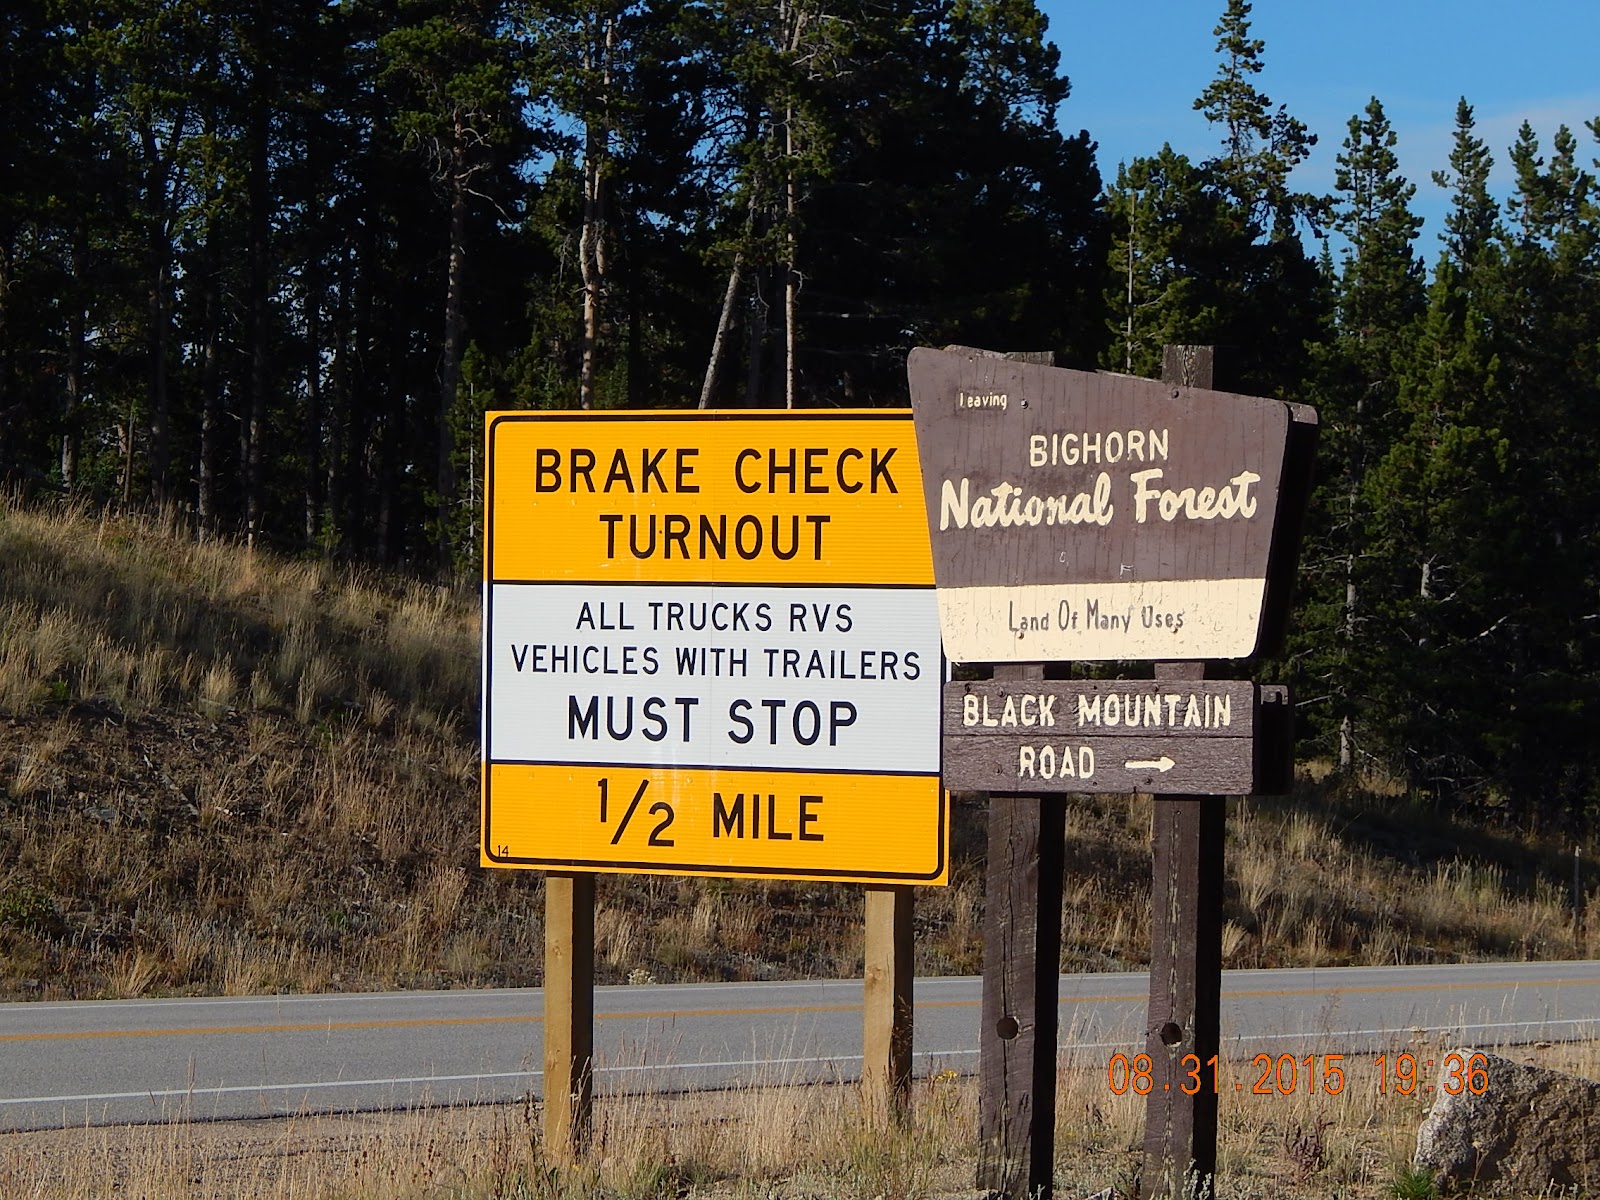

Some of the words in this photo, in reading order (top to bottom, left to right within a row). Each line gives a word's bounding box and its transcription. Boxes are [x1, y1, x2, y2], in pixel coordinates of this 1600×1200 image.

[1029, 429, 1169, 467] BIGHORN
[535, 448, 699, 493] BRAKE
[735, 448, 898, 493] CHECK
[939, 471, 1114, 531] National
[1130, 468, 1261, 523] Forest
[599, 515, 831, 560] TURNOUT
[576, 602, 634, 630] ALL
[648, 602, 772, 632] TRUCKS
[790, 604, 853, 633] RVS
[1008, 600, 1049, 632] Land
[1058, 599, 1078, 631] Of
[1086, 598, 1131, 634] Many
[1141, 604, 1184, 631] Uses
[511, 644, 659, 676] VEHICLES
[676, 646, 747, 677] WITH
[764, 649, 921, 680] TRAILERS
[568, 695, 699, 743] MUST
[728, 699, 858, 746] STOP
[962, 694, 1055, 727] BLACK
[1078, 693, 1231, 729] MOUNTAIN
[1018, 745, 1095, 779] ROAD
[597, 778, 675, 847] 1/2
[713, 793, 824, 842] MILE
[497, 845, 509, 857] 14
